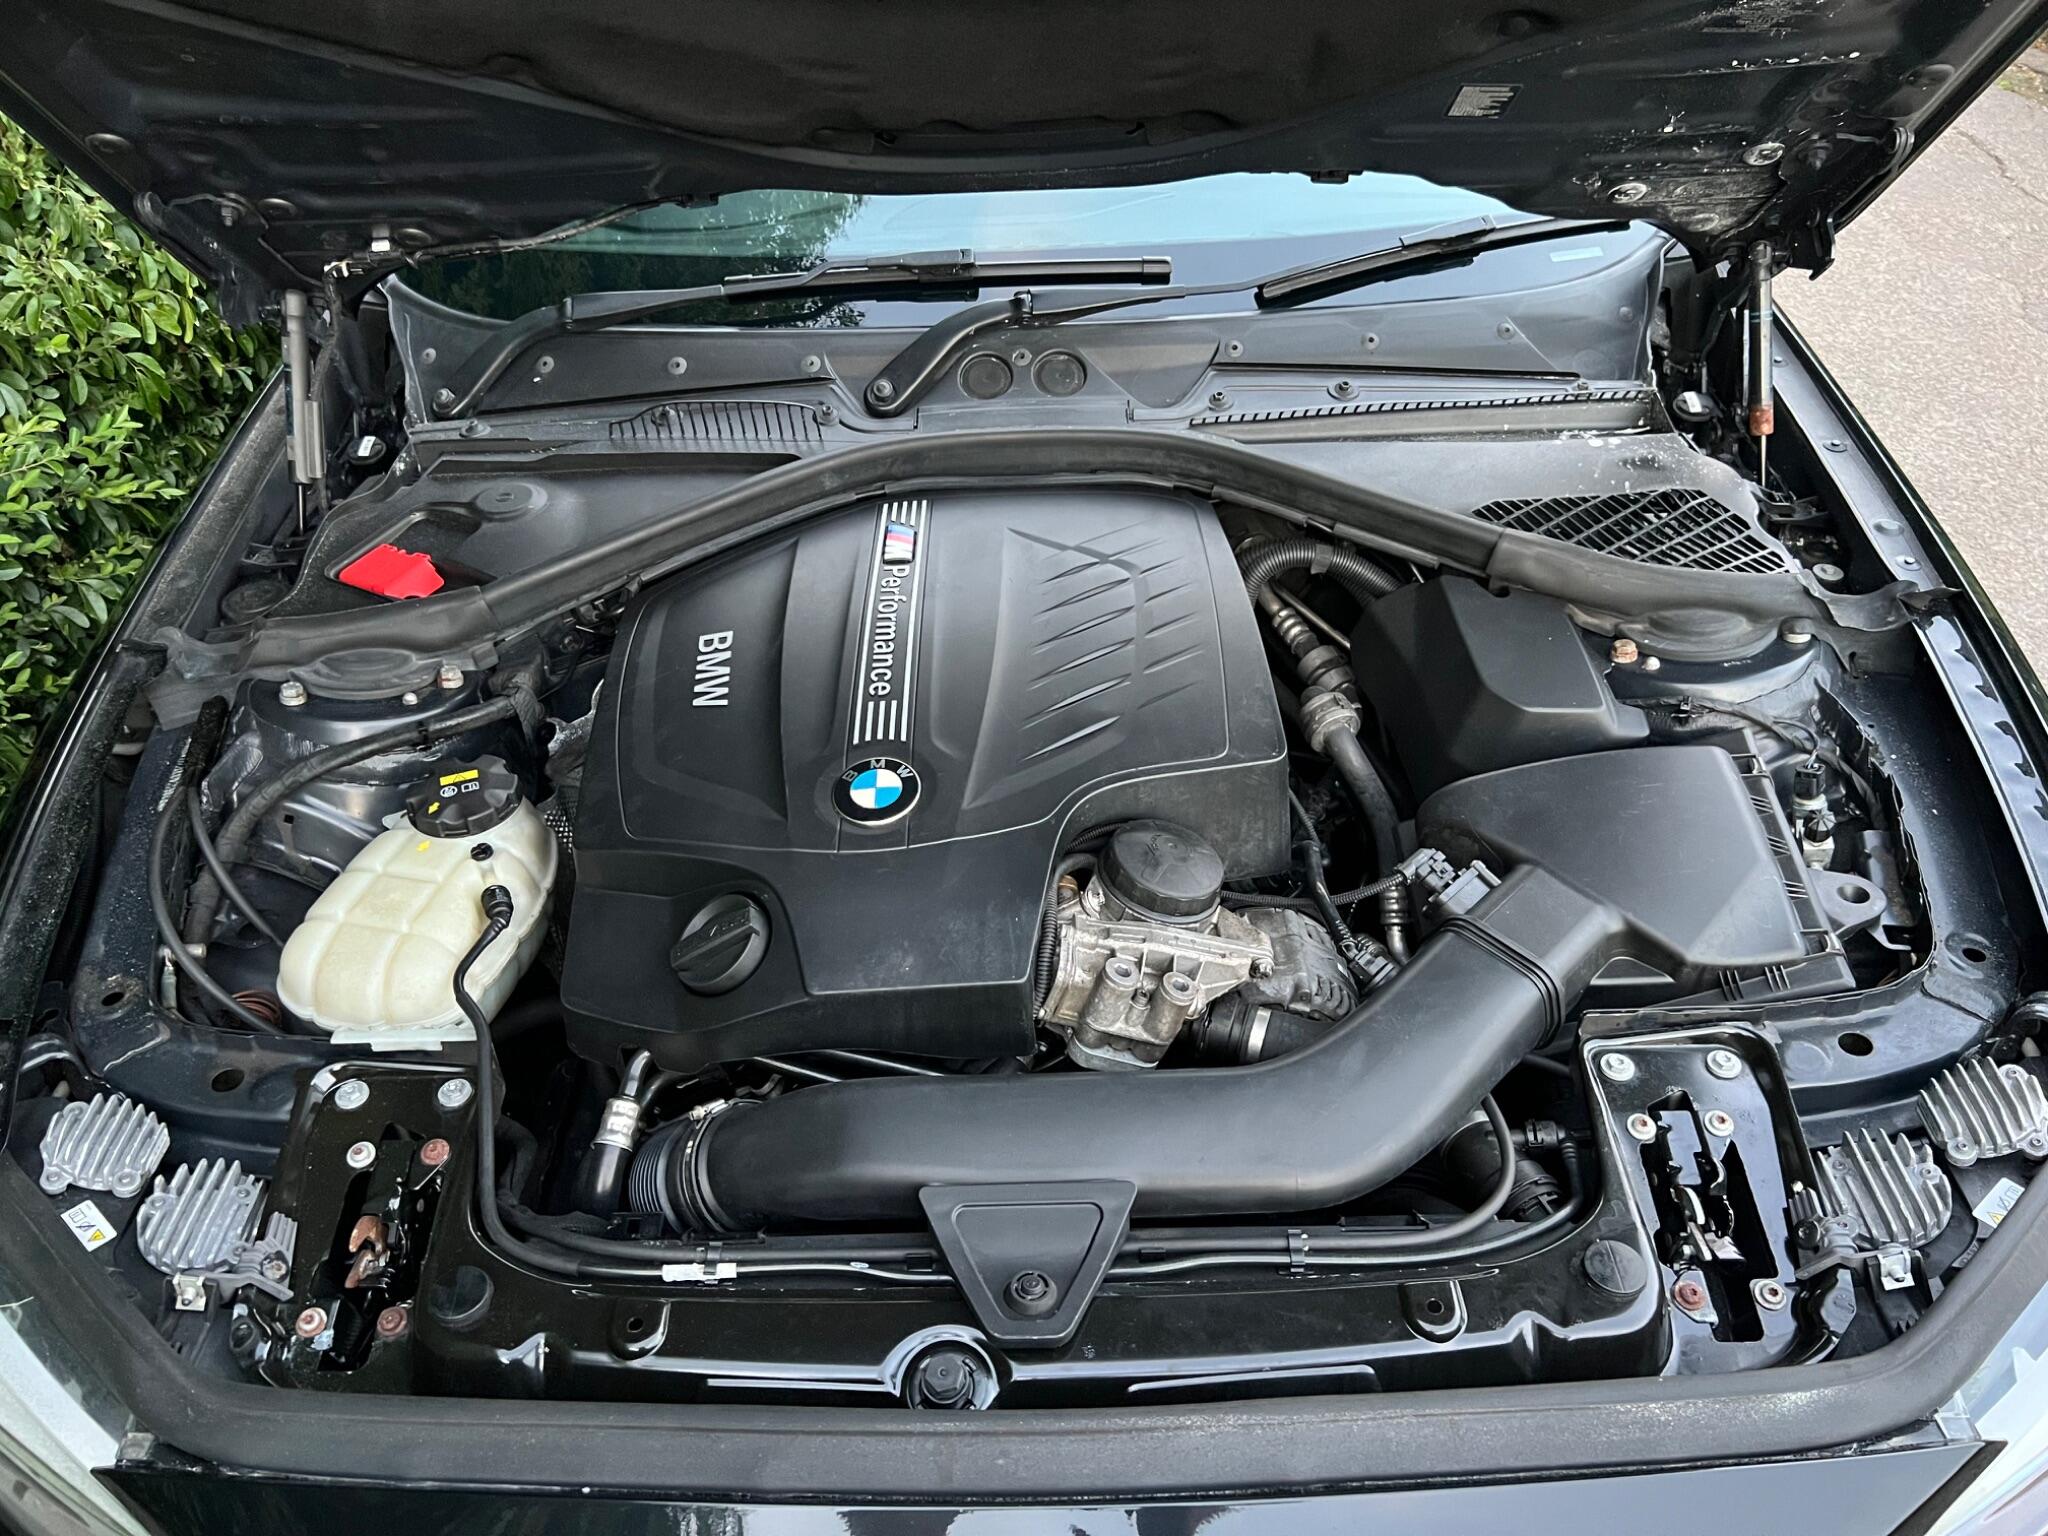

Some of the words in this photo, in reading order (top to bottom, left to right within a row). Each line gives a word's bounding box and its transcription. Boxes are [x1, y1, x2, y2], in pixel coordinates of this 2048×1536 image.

[692, 630, 734, 706] BMW
[868, 565, 910, 696] Performance
[841, 759, 914, 782] BMW
